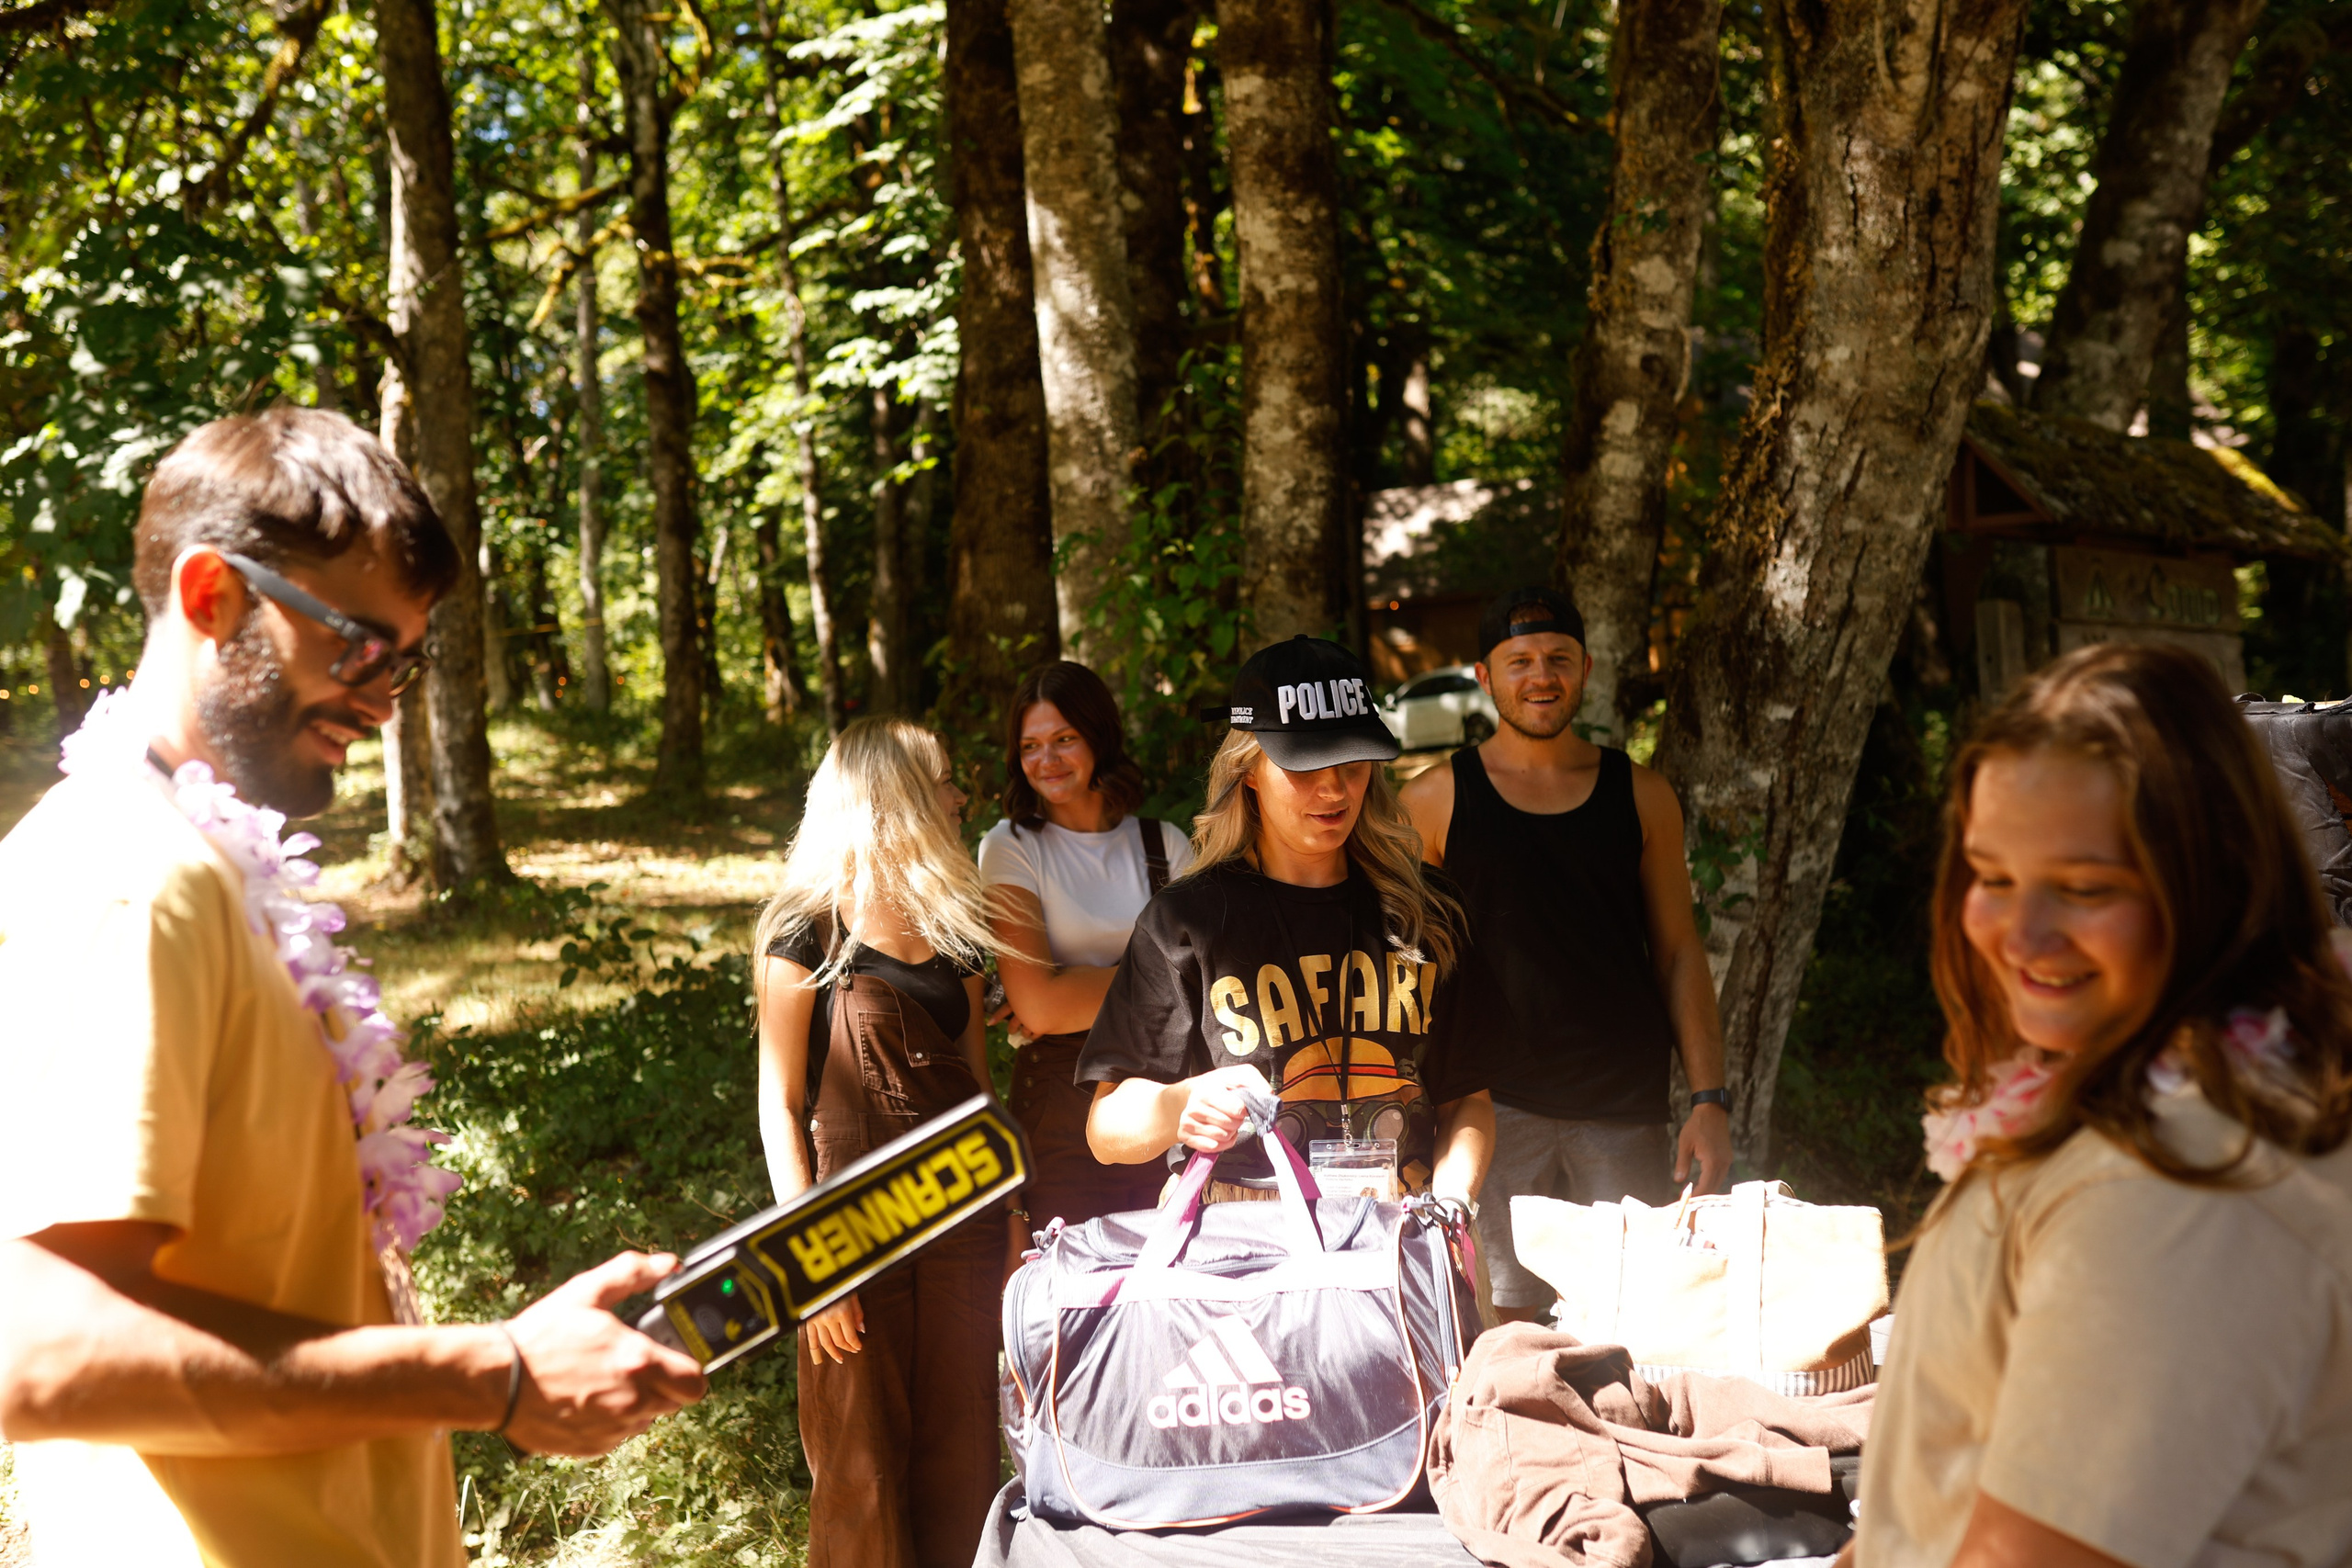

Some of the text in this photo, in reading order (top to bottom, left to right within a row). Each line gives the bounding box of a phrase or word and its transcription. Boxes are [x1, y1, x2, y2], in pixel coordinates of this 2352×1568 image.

[1277, 678, 1368, 724] POLICE
[1209, 950, 1437, 1057] SAFARI
[786, 1129, 1002, 1283] SCANNER
[1146, 1382, 1312, 1430] adidas
